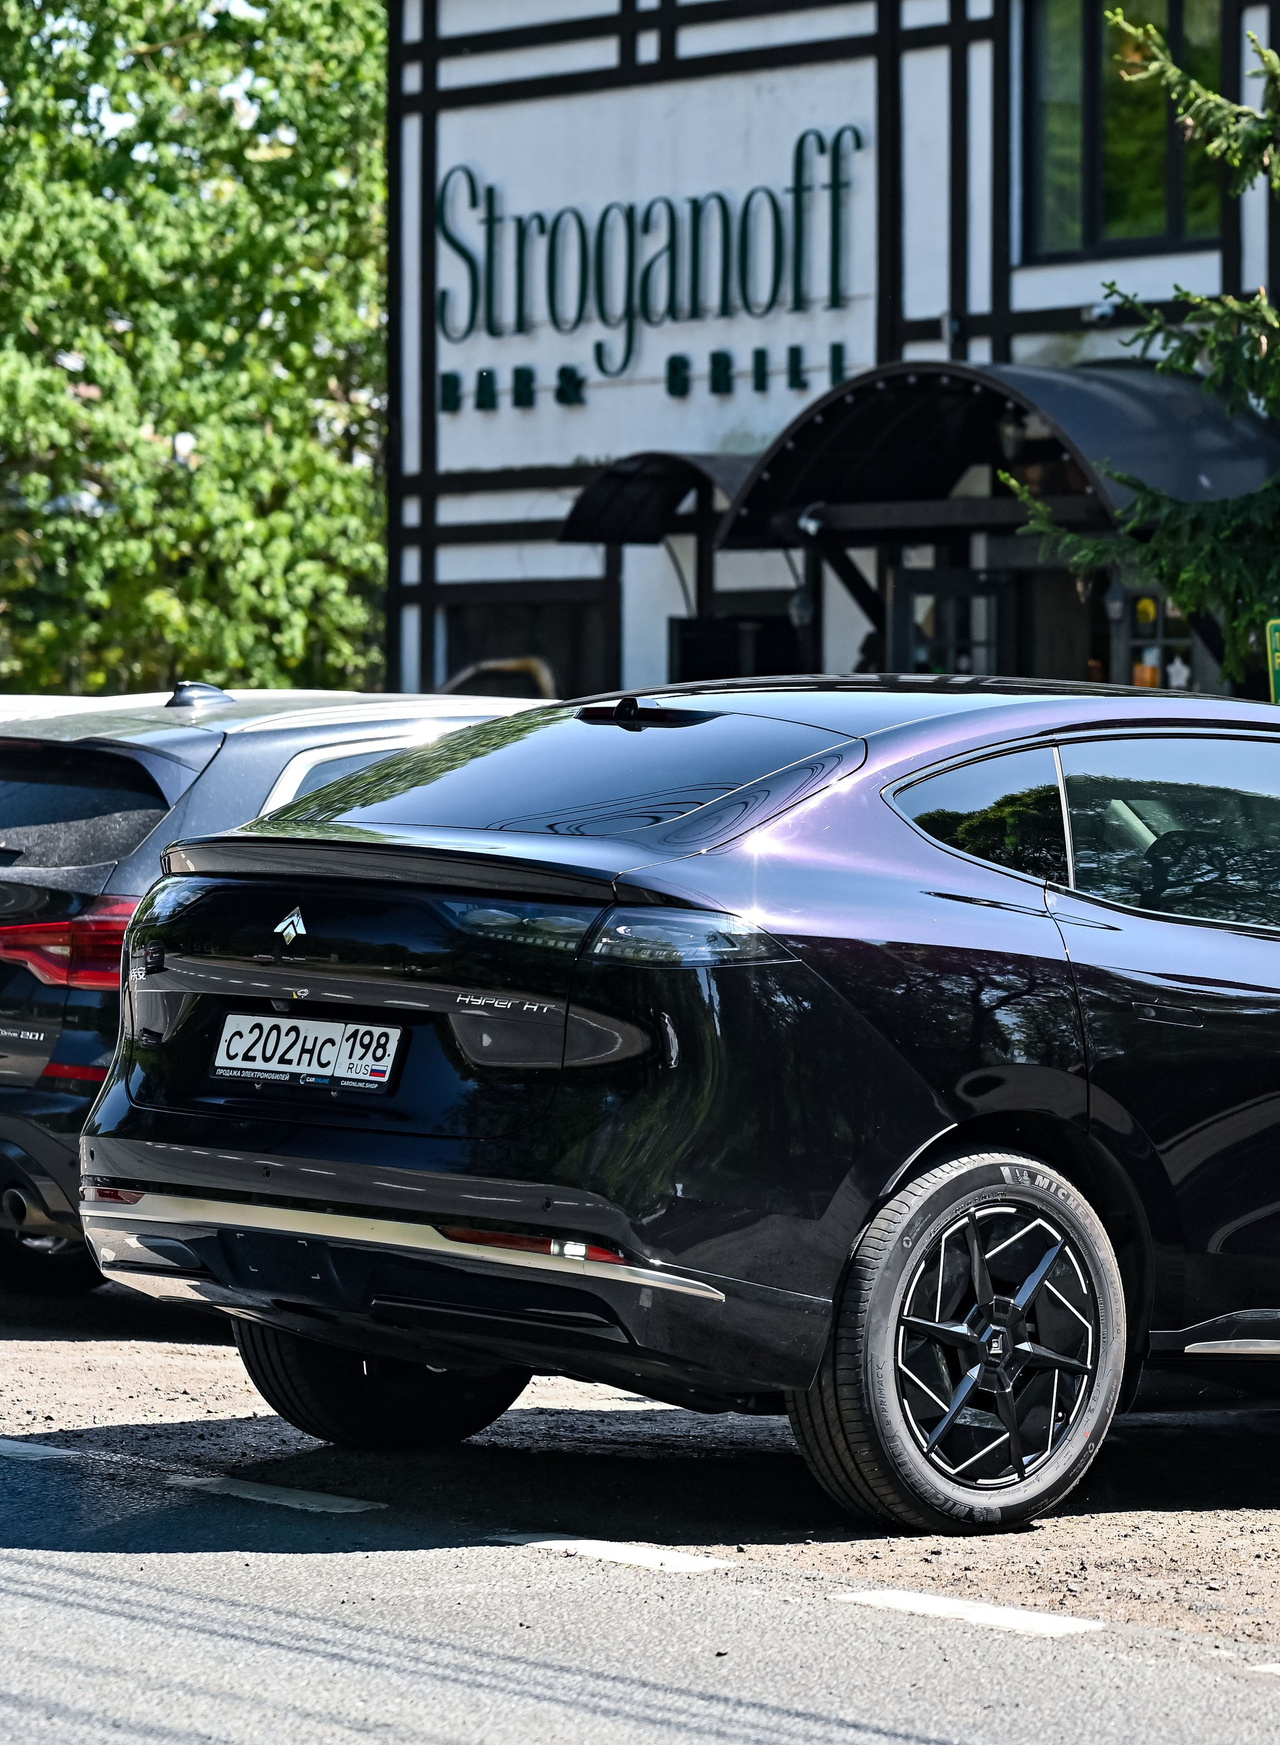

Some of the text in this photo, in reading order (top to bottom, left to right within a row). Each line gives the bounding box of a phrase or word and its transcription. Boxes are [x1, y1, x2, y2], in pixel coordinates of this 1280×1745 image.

[437, 124, 863, 377] Stroganoff
[666, 342, 847, 398] GRILL
[523, 1001, 556, 1013] HT
[345, 1028, 390, 1063] 198
[215, 1068, 290, 1081] ПРОДАЖА ЭЛЕКТРОМОБИЛЕЙ
[346, 1062, 370, 1076] RUS
[1034, 1174, 1105, 1248] MICHEL
[889, 1442, 970, 1518] MICHELIN
